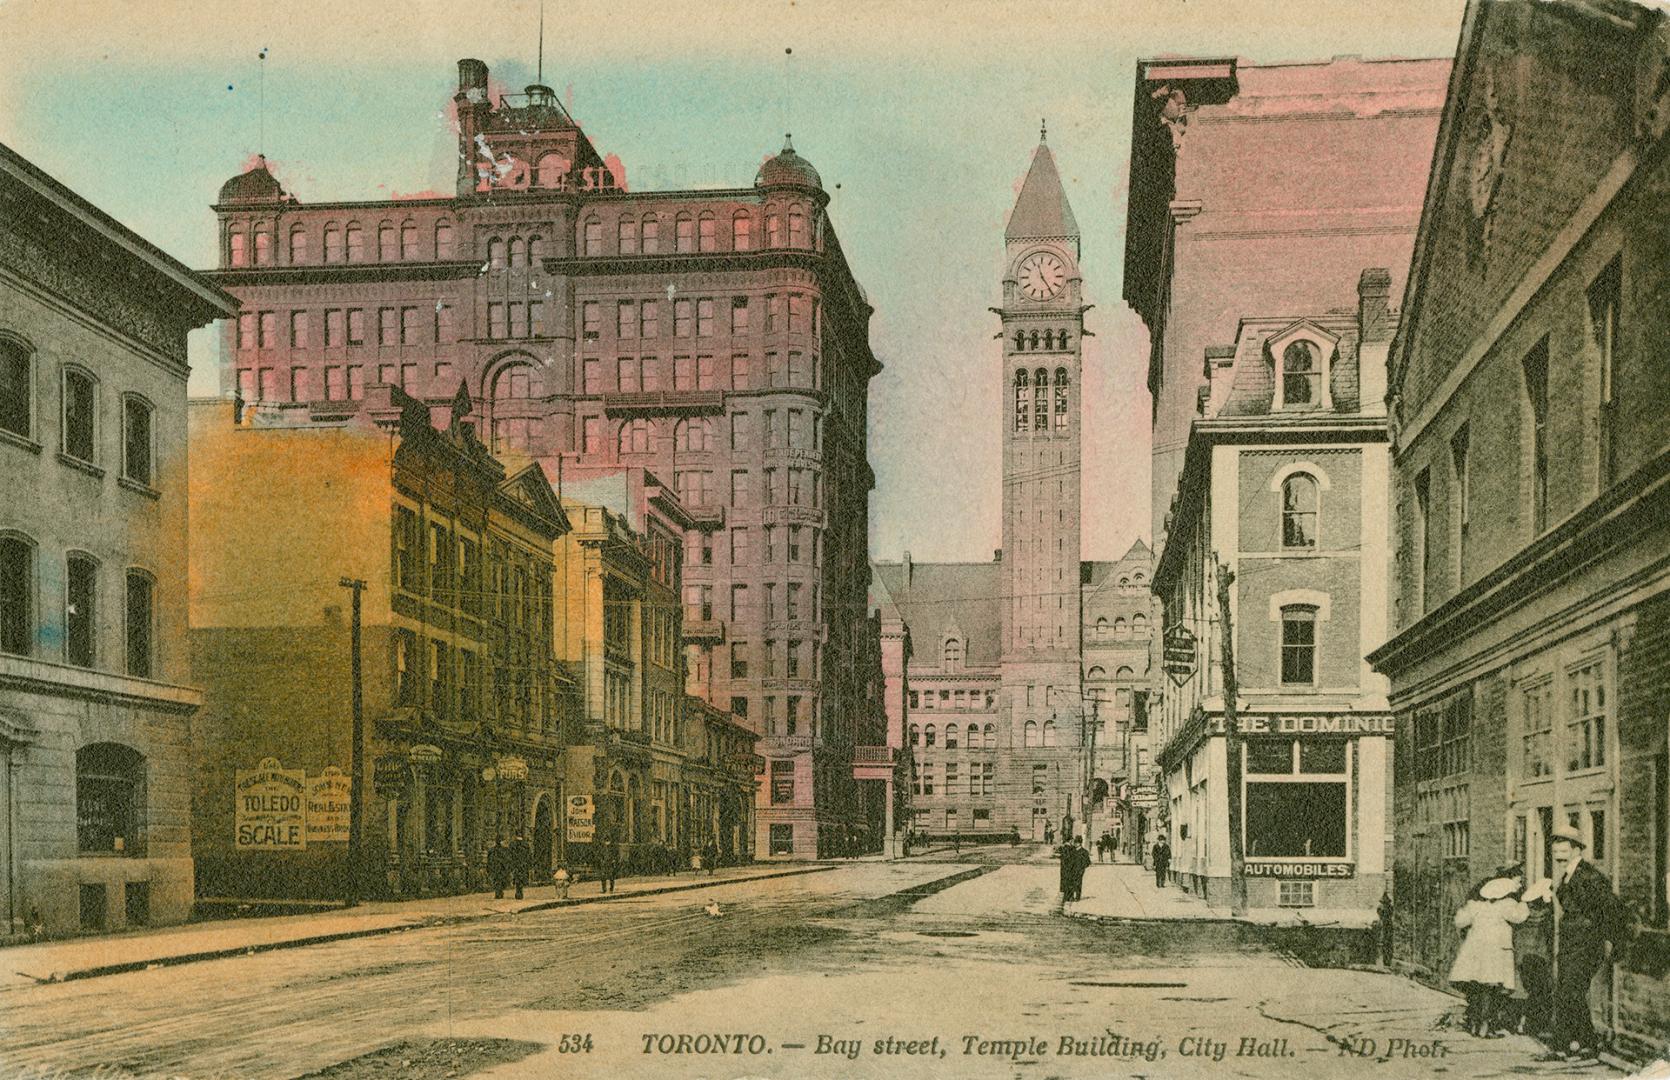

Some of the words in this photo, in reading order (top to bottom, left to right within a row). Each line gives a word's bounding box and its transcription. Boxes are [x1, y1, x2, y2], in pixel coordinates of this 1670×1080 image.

[500, 769, 524, 780] FURS
[243, 795, 300, 812] TOLEDO
[239, 824, 300, 845] SCALE
[1244, 863, 1352, 877] AUTOMOBILES.
